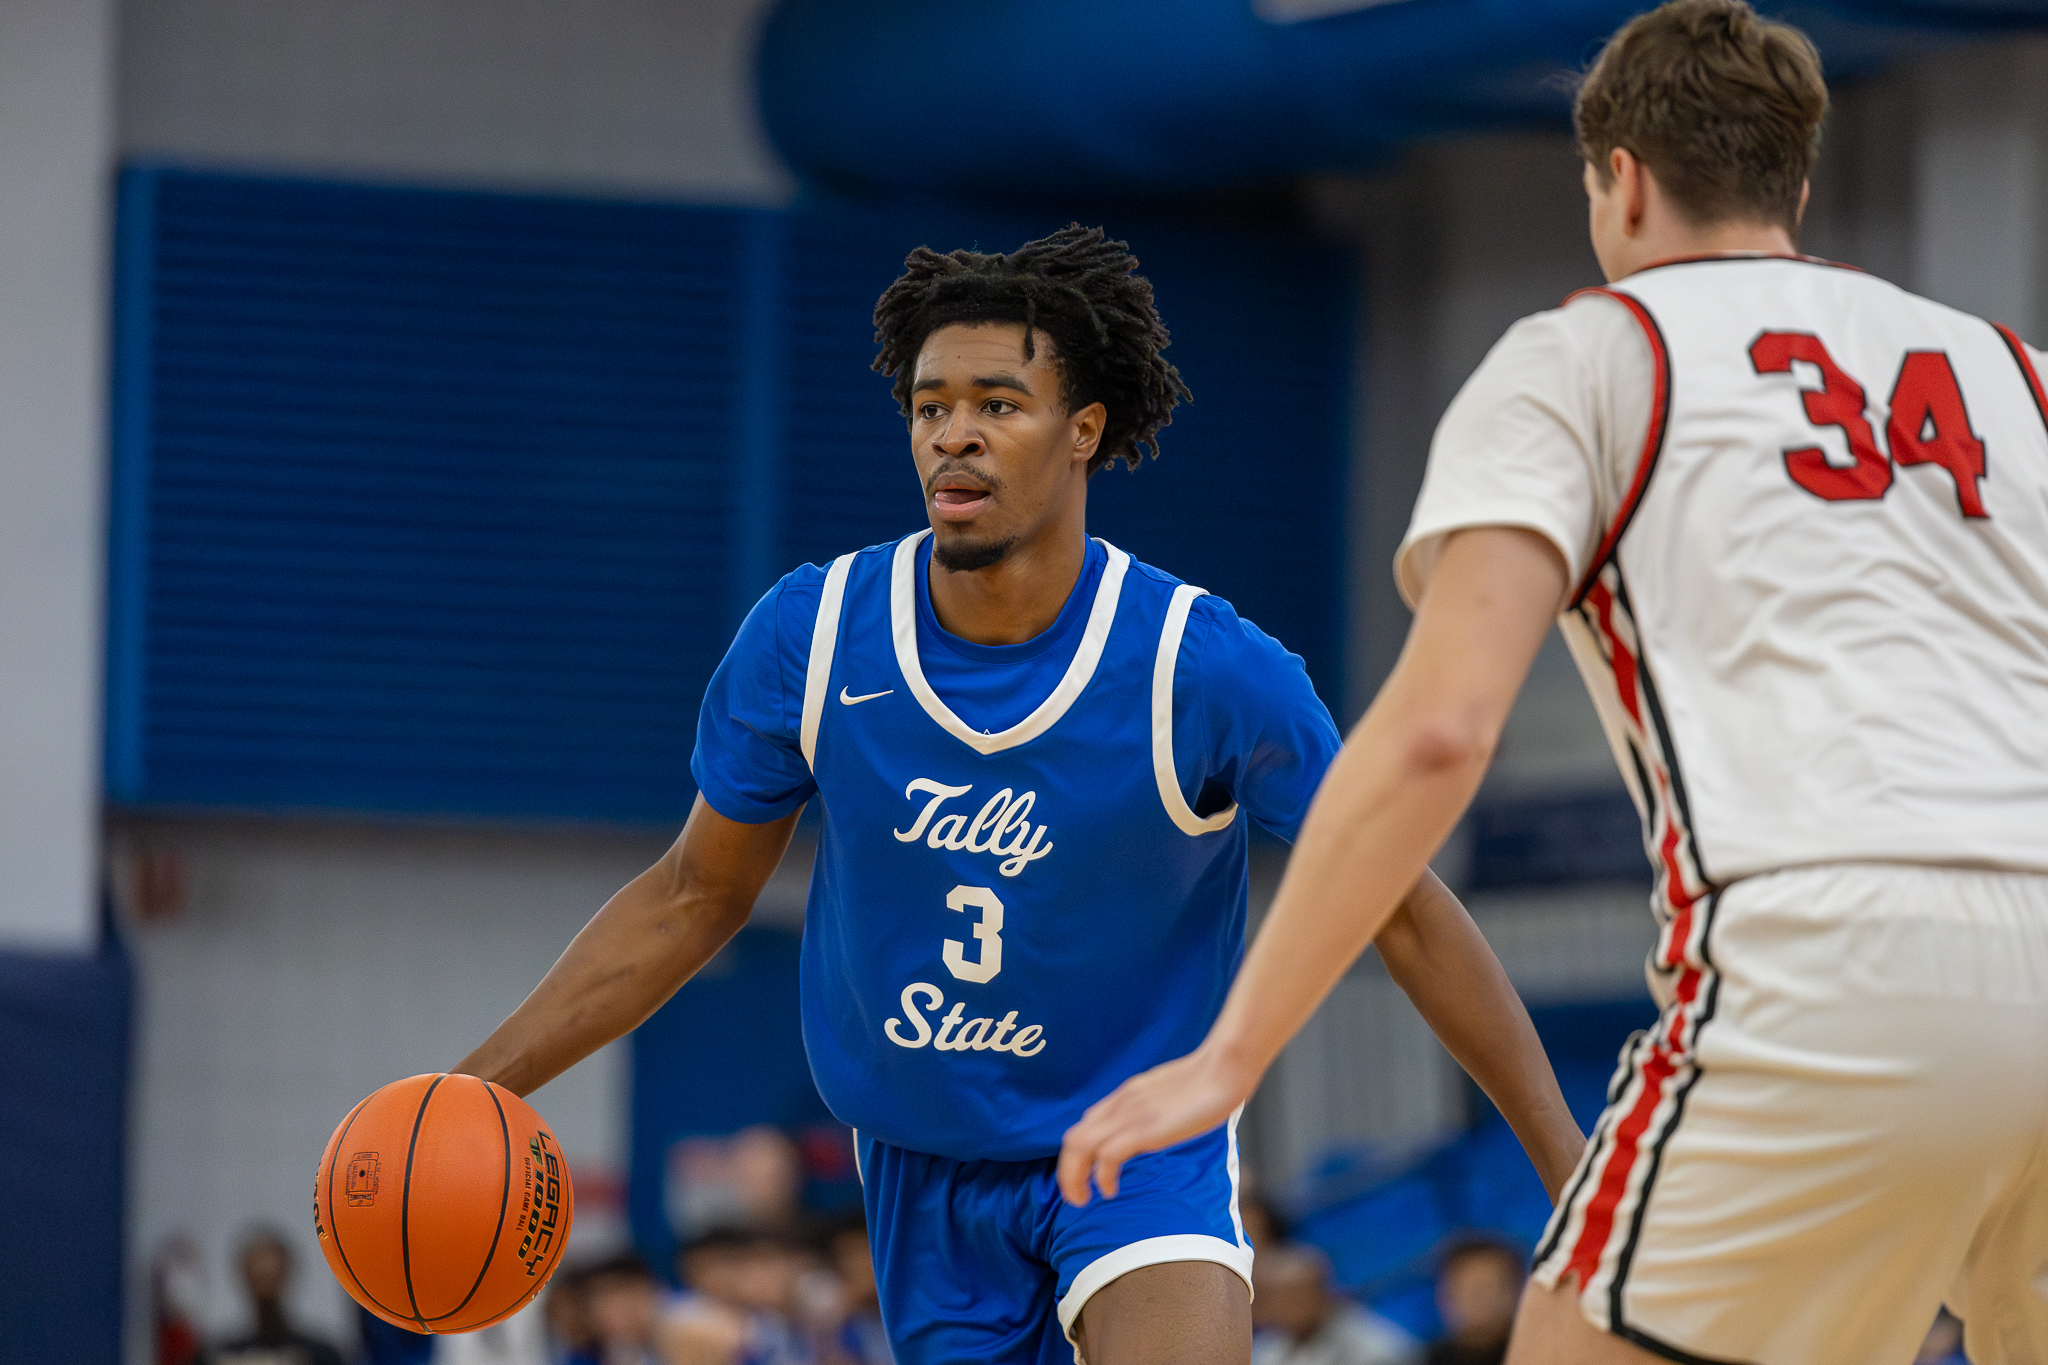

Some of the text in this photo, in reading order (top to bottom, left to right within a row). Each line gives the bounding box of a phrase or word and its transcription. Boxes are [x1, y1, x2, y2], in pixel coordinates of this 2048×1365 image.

[1747, 328, 1991, 519] 34
[893, 777, 1053, 877] Tally
[942, 884, 1004, 984] 3
[884, 982, 1046, 1057] State
[515, 1214, 527, 1232] BALL
[525, 1130, 560, 1277] LEGACY
